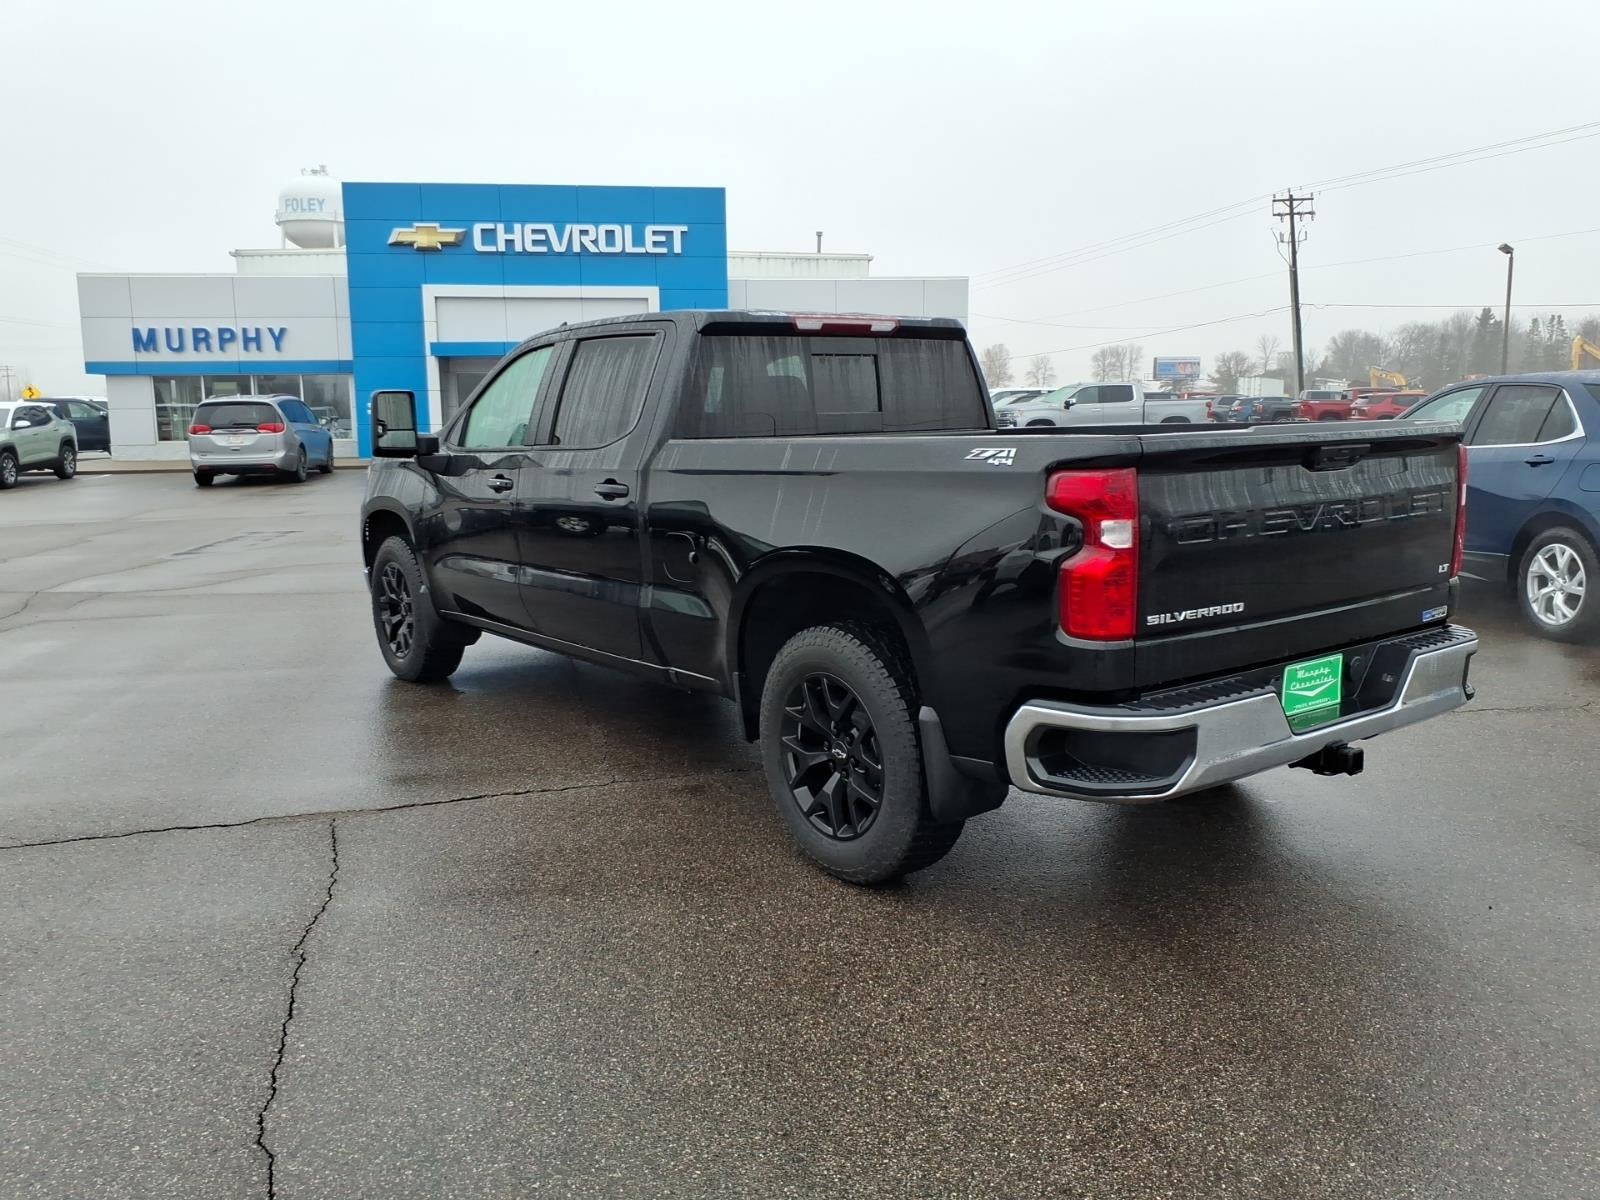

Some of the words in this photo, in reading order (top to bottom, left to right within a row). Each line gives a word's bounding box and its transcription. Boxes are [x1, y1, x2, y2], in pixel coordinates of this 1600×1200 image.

[285, 198, 326, 213] FOLEY
[473, 223, 688, 254] CHEVROLET
[131, 327, 288, 353] MURPHY
[964, 447, 1018, 460] Z71
[1176, 491, 1450, 545] CHEVROLET
[1438, 563, 1450, 573] LT
[1146, 602, 1245, 626] SILVERADO
